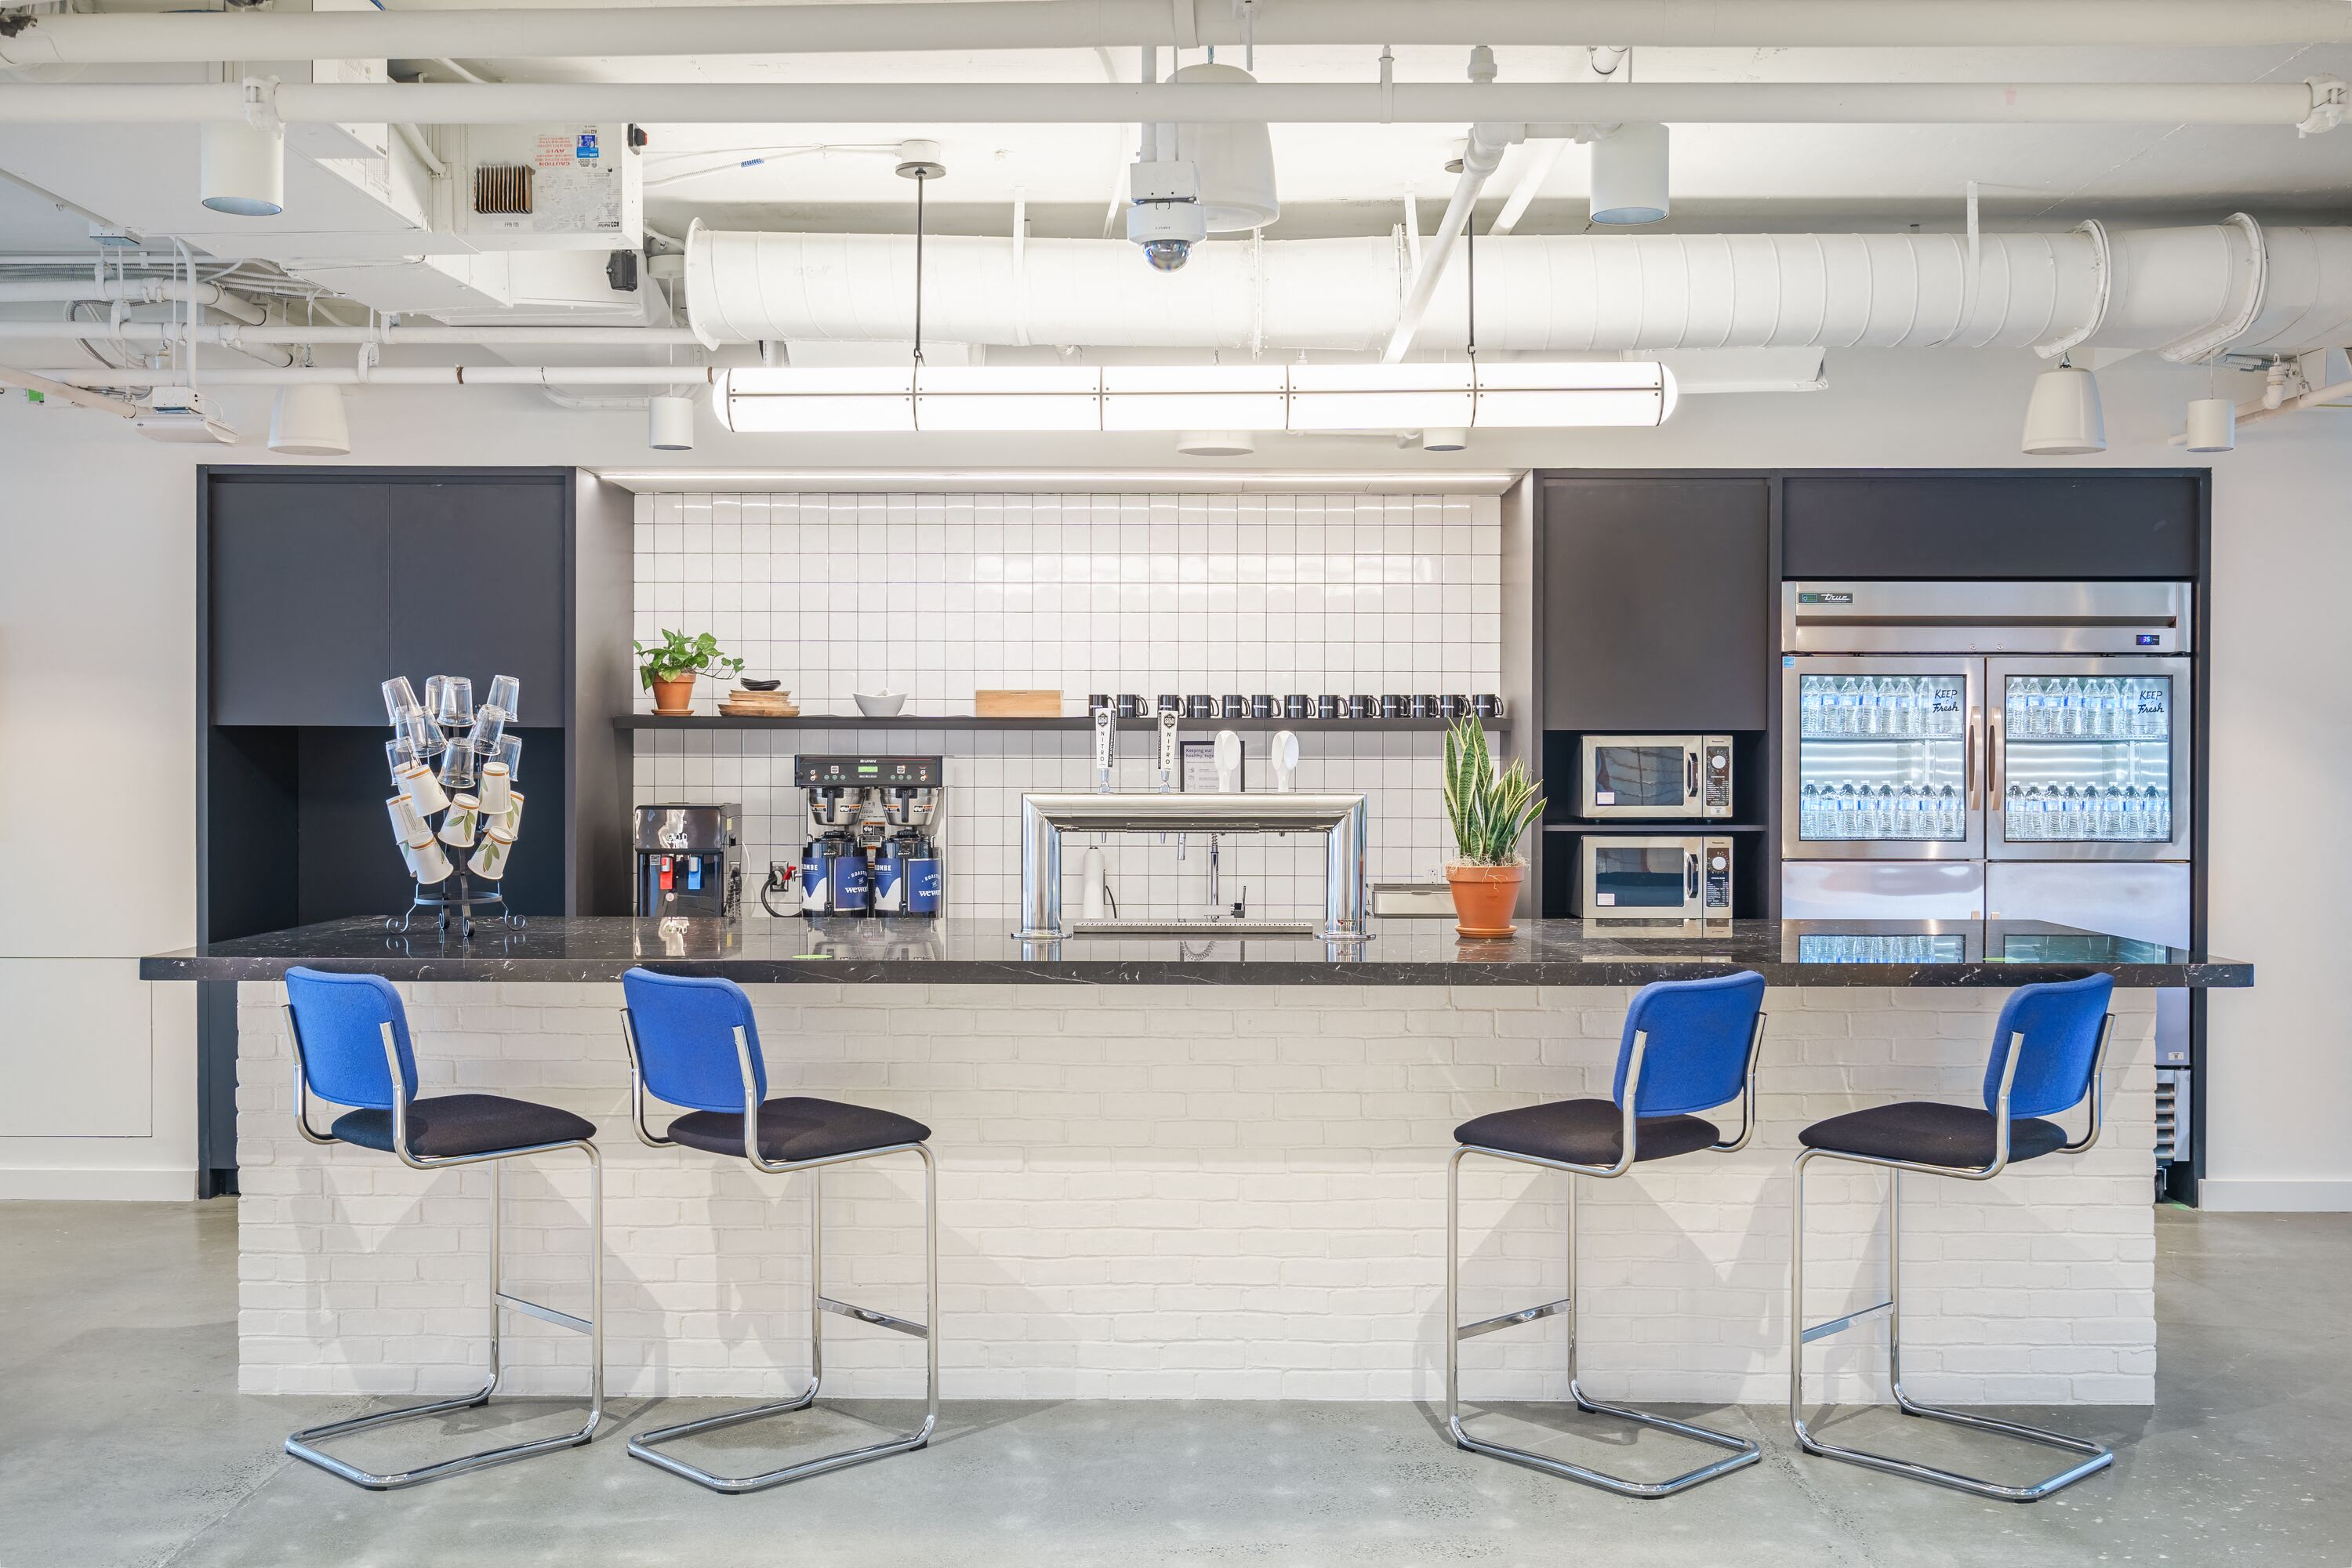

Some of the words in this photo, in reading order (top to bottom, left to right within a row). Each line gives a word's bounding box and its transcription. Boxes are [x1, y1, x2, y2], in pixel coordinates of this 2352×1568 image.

[1934, 688, 1958, 699] KEEP
[2139, 690, 2163, 700] KEEP
[1932, 701, 1960, 713] Fresh
[2137, 702, 2165, 714] Fresh
